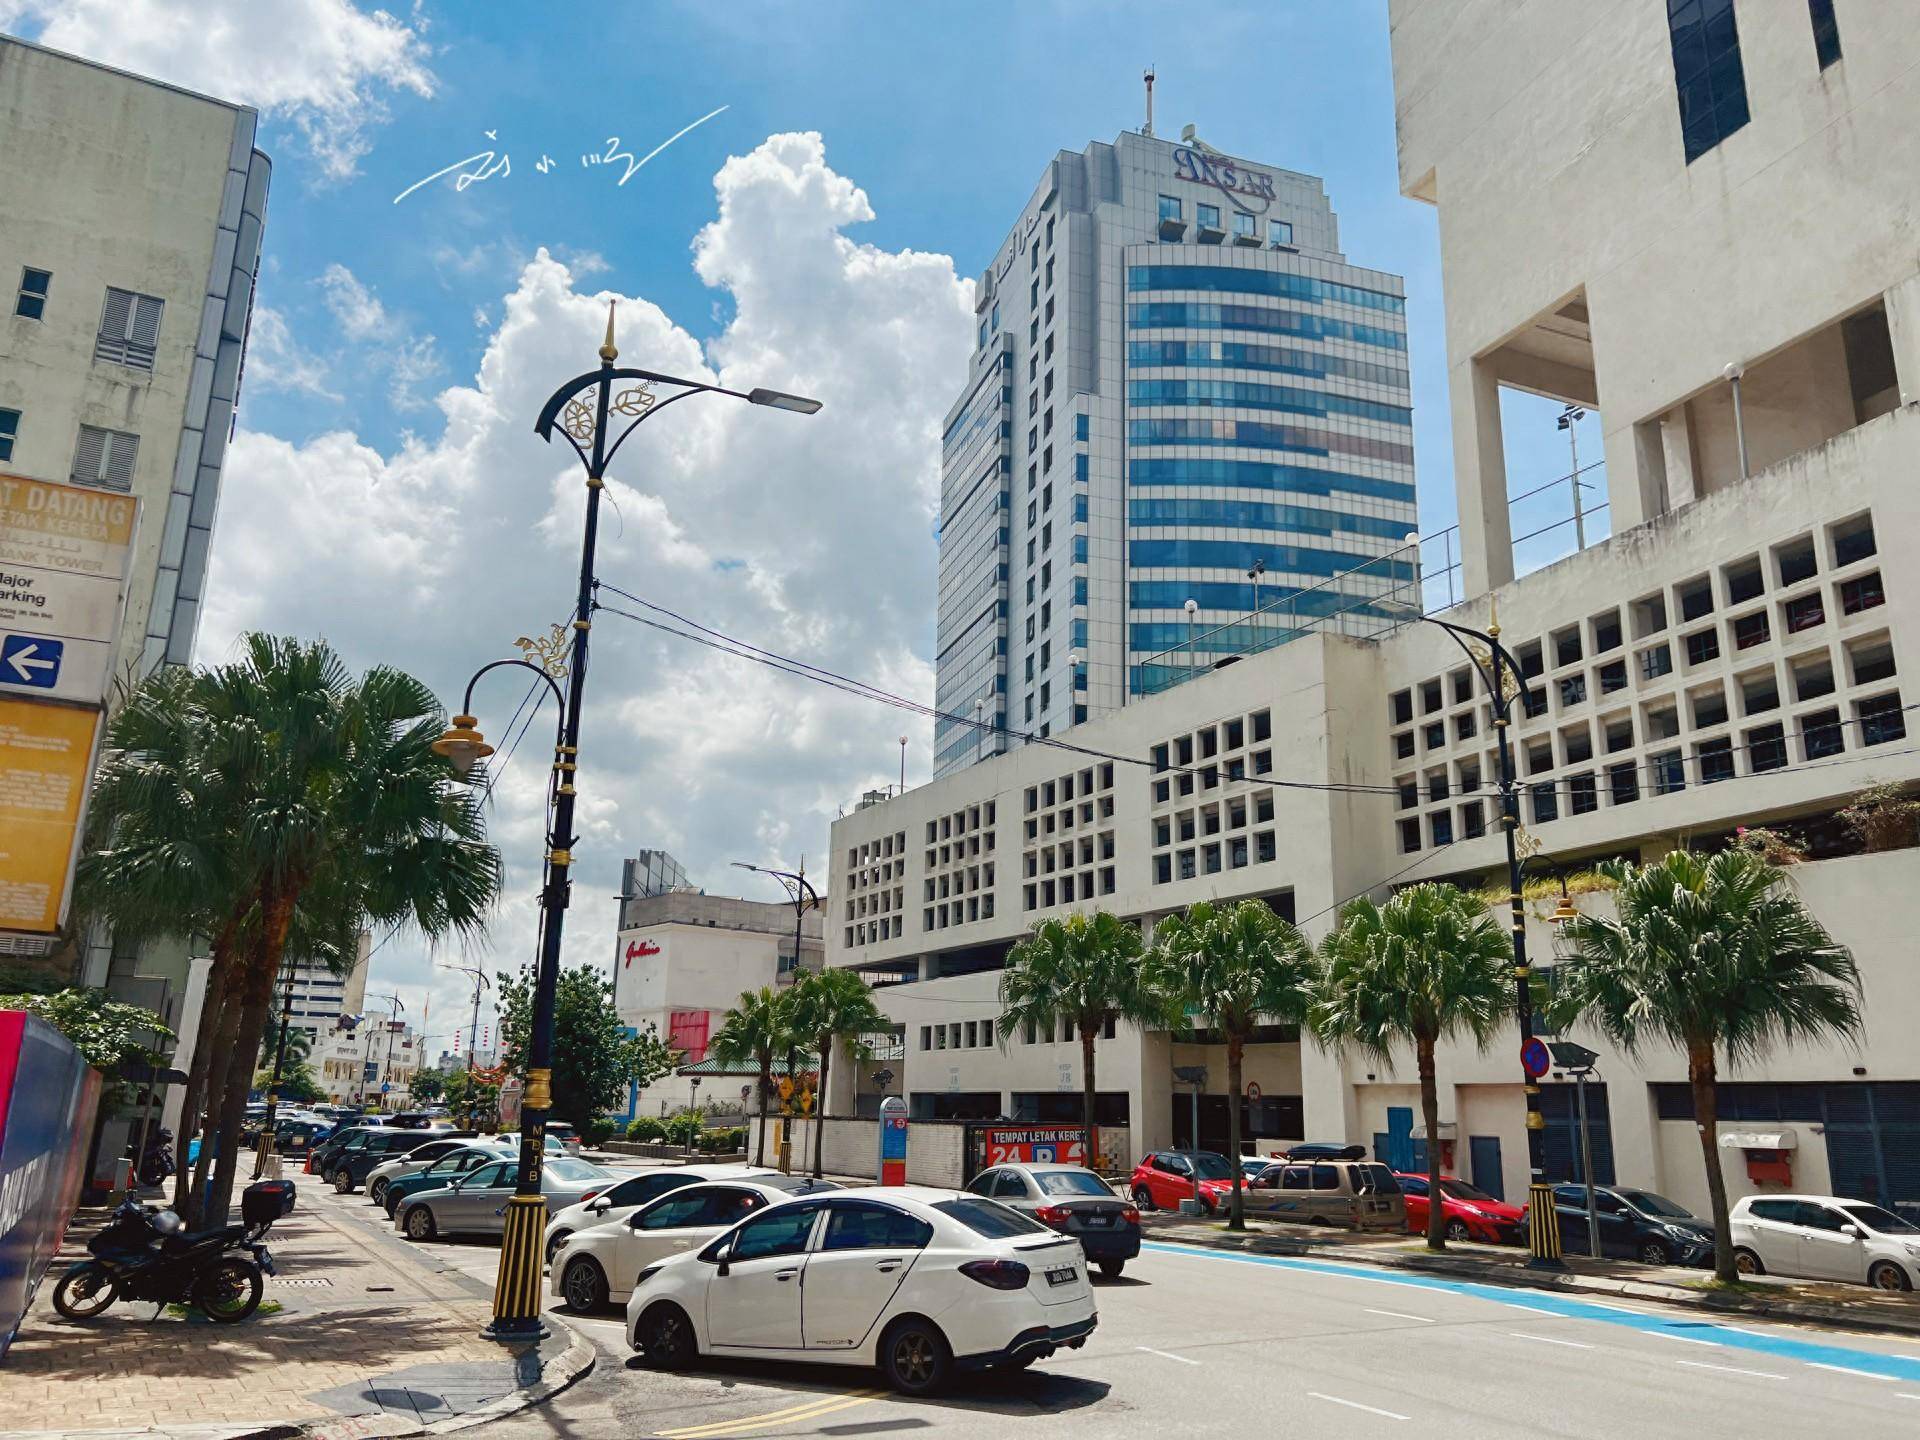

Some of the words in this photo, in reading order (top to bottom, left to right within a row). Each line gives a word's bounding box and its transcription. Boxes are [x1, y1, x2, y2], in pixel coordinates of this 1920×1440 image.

[27, 487, 126, 525] DATANG
[47, 515, 109, 540] KERETA
[46, 554, 104, 572] TOWER
[993, 1132, 1028, 1144] TEMPAT
[1029, 1131, 1057, 1142] LETAK
[992, 1146, 1022, 1166] 24
